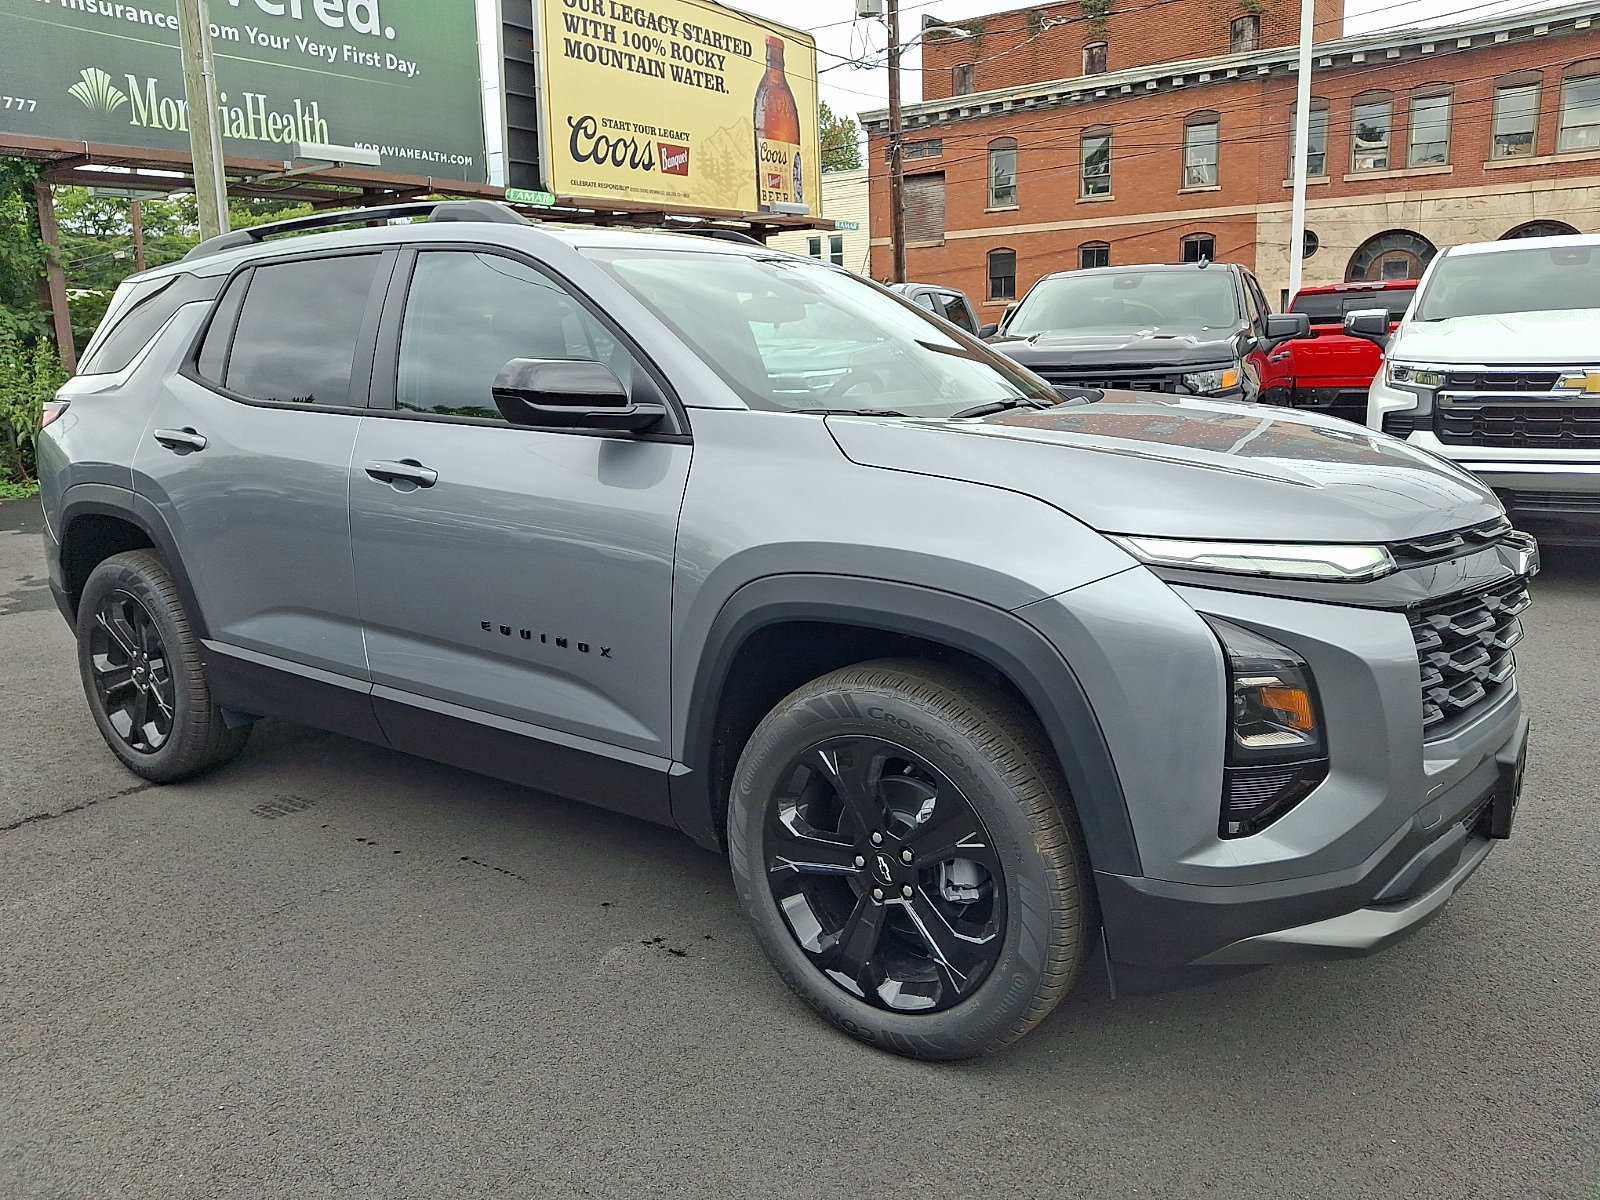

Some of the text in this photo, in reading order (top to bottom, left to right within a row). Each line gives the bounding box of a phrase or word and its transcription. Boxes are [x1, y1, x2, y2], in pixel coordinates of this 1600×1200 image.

[562, 12, 726, 71] WITH 100% ROCKY
[609, 0, 680, 37] LEGACY
[682, 22, 753, 58] STARTED
[245, 25, 290, 50] Your
[295, 35, 338, 63] Very
[343, 45, 381, 68] First
[386, 53, 420, 78] Day.
[563, 38, 730, 94] MOUNTAIN WATER.
[0, 96, 37, 112] 777
[125, 74, 329, 144] MoriaHealth
[602, 118, 690, 142] START YOUR LEGACY
[354, 141, 473, 166] MORAVIAHEALTH.COM
[567, 115, 656, 171] Coors
[760, 141, 788, 165] Coors
[661, 147, 688, 171] Banquet
[570, 179, 597, 188] CELEBRATE
[761, 189, 789, 202] BEER
[510, 190, 550, 203] LAMAR
[481, 619, 612, 659] EQUINOX
